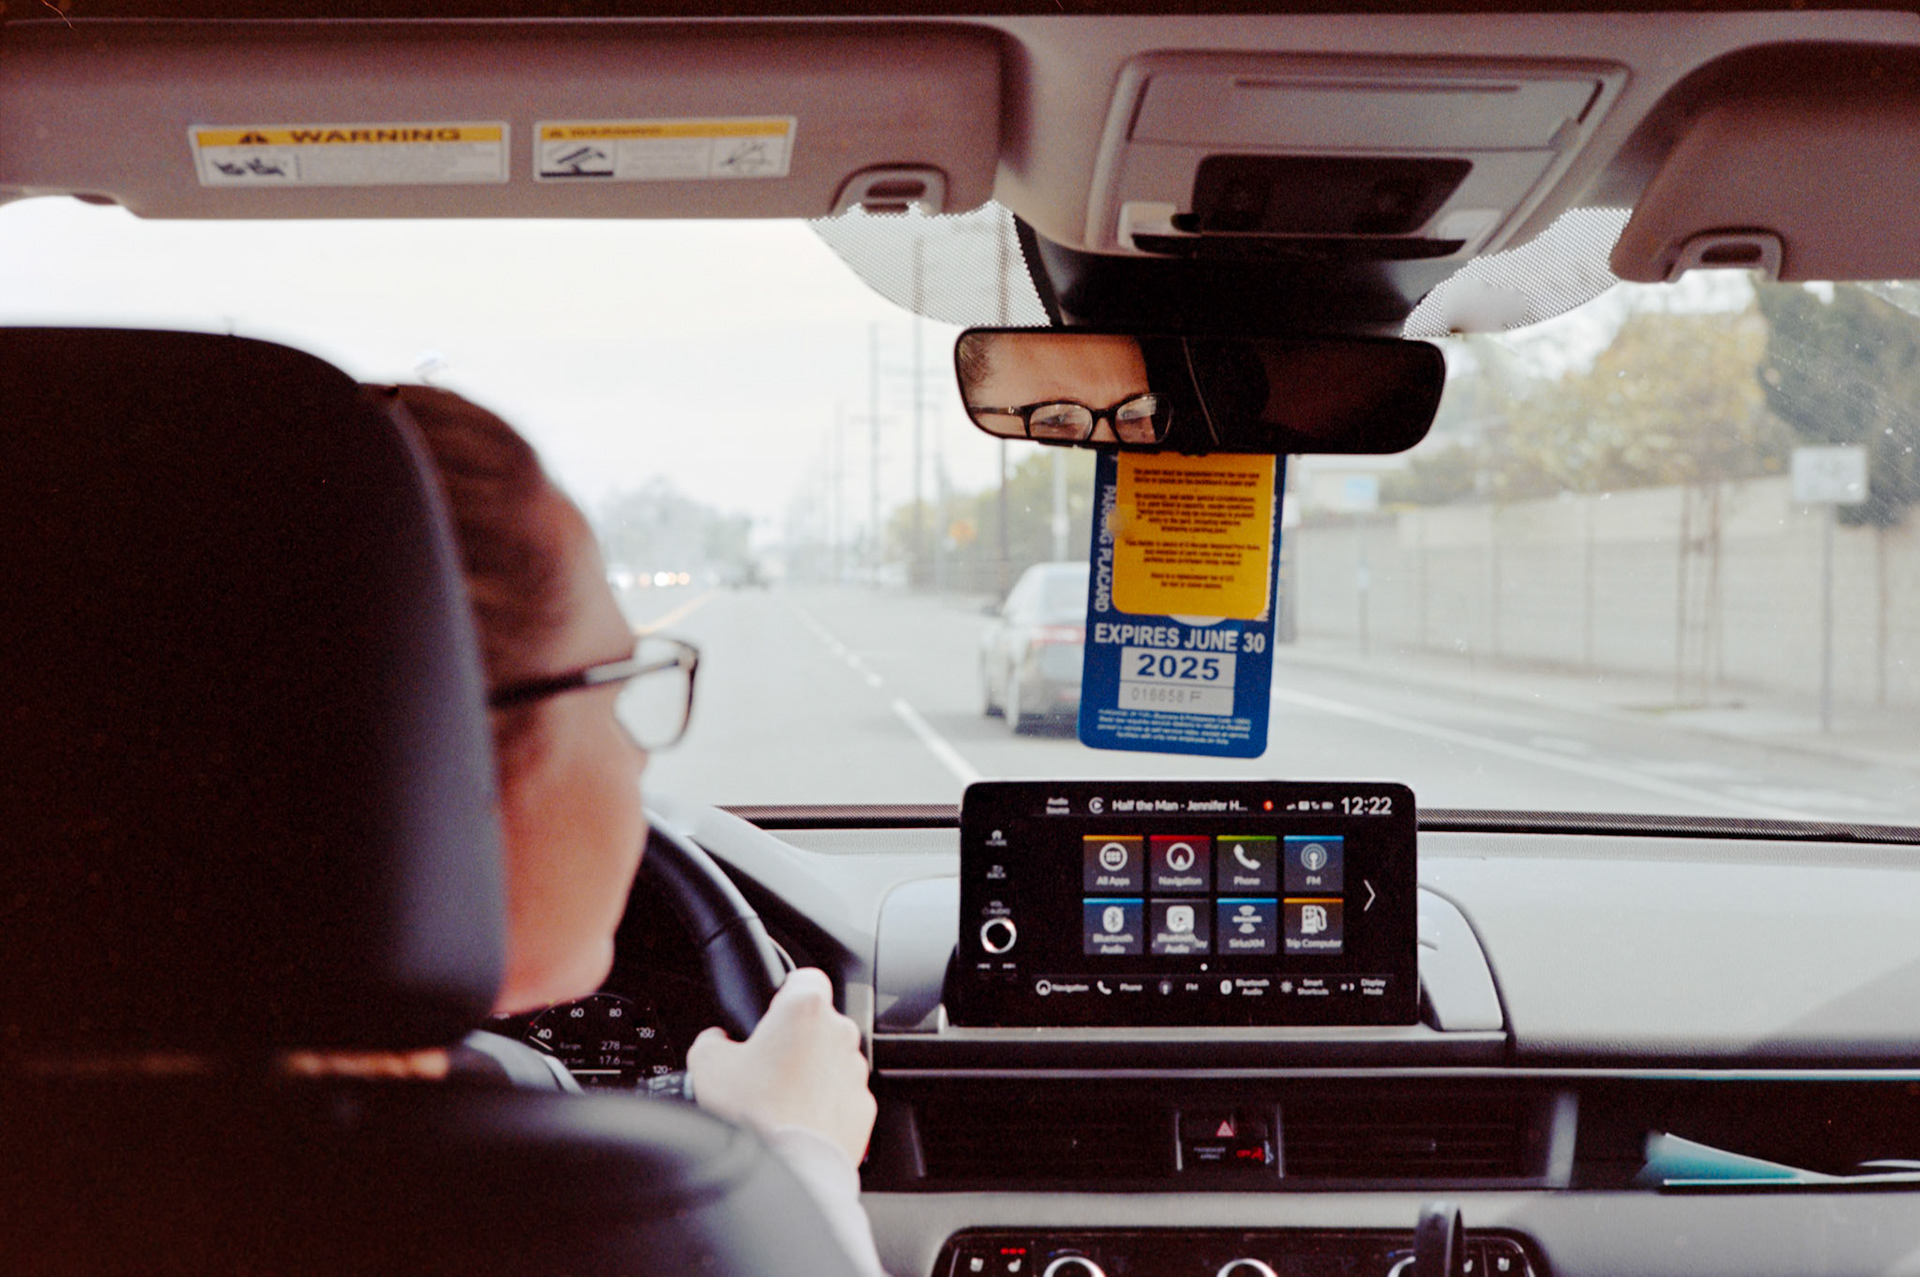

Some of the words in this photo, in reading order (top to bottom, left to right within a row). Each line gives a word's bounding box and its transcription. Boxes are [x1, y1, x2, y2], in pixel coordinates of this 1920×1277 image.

[291, 128, 461, 143] WARNING
[1094, 547, 1113, 613] PLACARD
[1094, 623, 1180, 648] EXPIRES
[1184, 629, 1239, 652] JUNE
[1242, 633, 1266, 654] 30
[1137, 654, 1220, 680] 2025
[1112, 799, 1135, 812] Half
[1136, 799, 1154, 812] the
[1155, 799, 1179, 812] Man
[1187, 799, 1228, 812] Jennifer
[1340, 796, 1392, 815] 12:22
[1109, 876, 1130, 888] Apps
[1158, 876, 1203, 888] Navigation
[1233, 876, 1261, 886] Phone
[1305, 876, 1322, 886] FM
[1092, 933, 1134, 944] Bluetooth
[1228, 938, 1265, 949] SiriusXM
[1285, 938, 1301, 950] Trip
[1302, 938, 1342, 950] Computer
[1100, 944, 1126, 954] Audio
[1164, 944, 1191, 954] Audio
[1119, 982, 1143, 992] Phone
[570, 1007, 585, 1019] 60
[608, 1007, 623, 1018] 80
[536, 1028, 553, 1040] 40
[600, 1040, 621, 1051] 278
[599, 1055, 621, 1066] 17.6
[652, 1064, 669, 1075] 120
